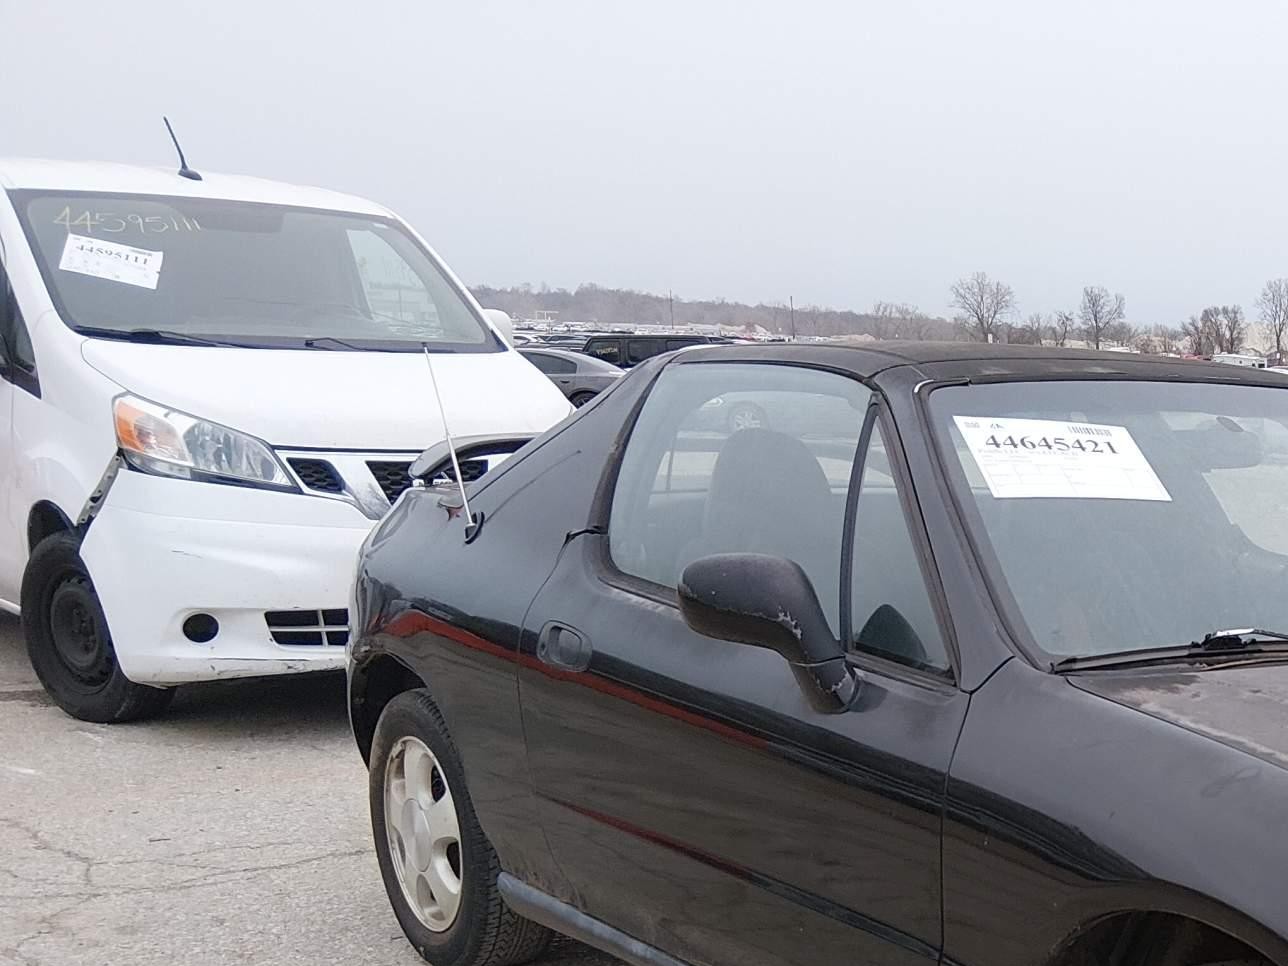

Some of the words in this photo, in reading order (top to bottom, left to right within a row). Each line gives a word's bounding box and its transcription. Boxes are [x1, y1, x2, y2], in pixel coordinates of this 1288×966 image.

[53, 205, 202, 234] 44595111
[75, 243, 149, 265] 44595111
[985, 433, 1120, 455] 44645421
